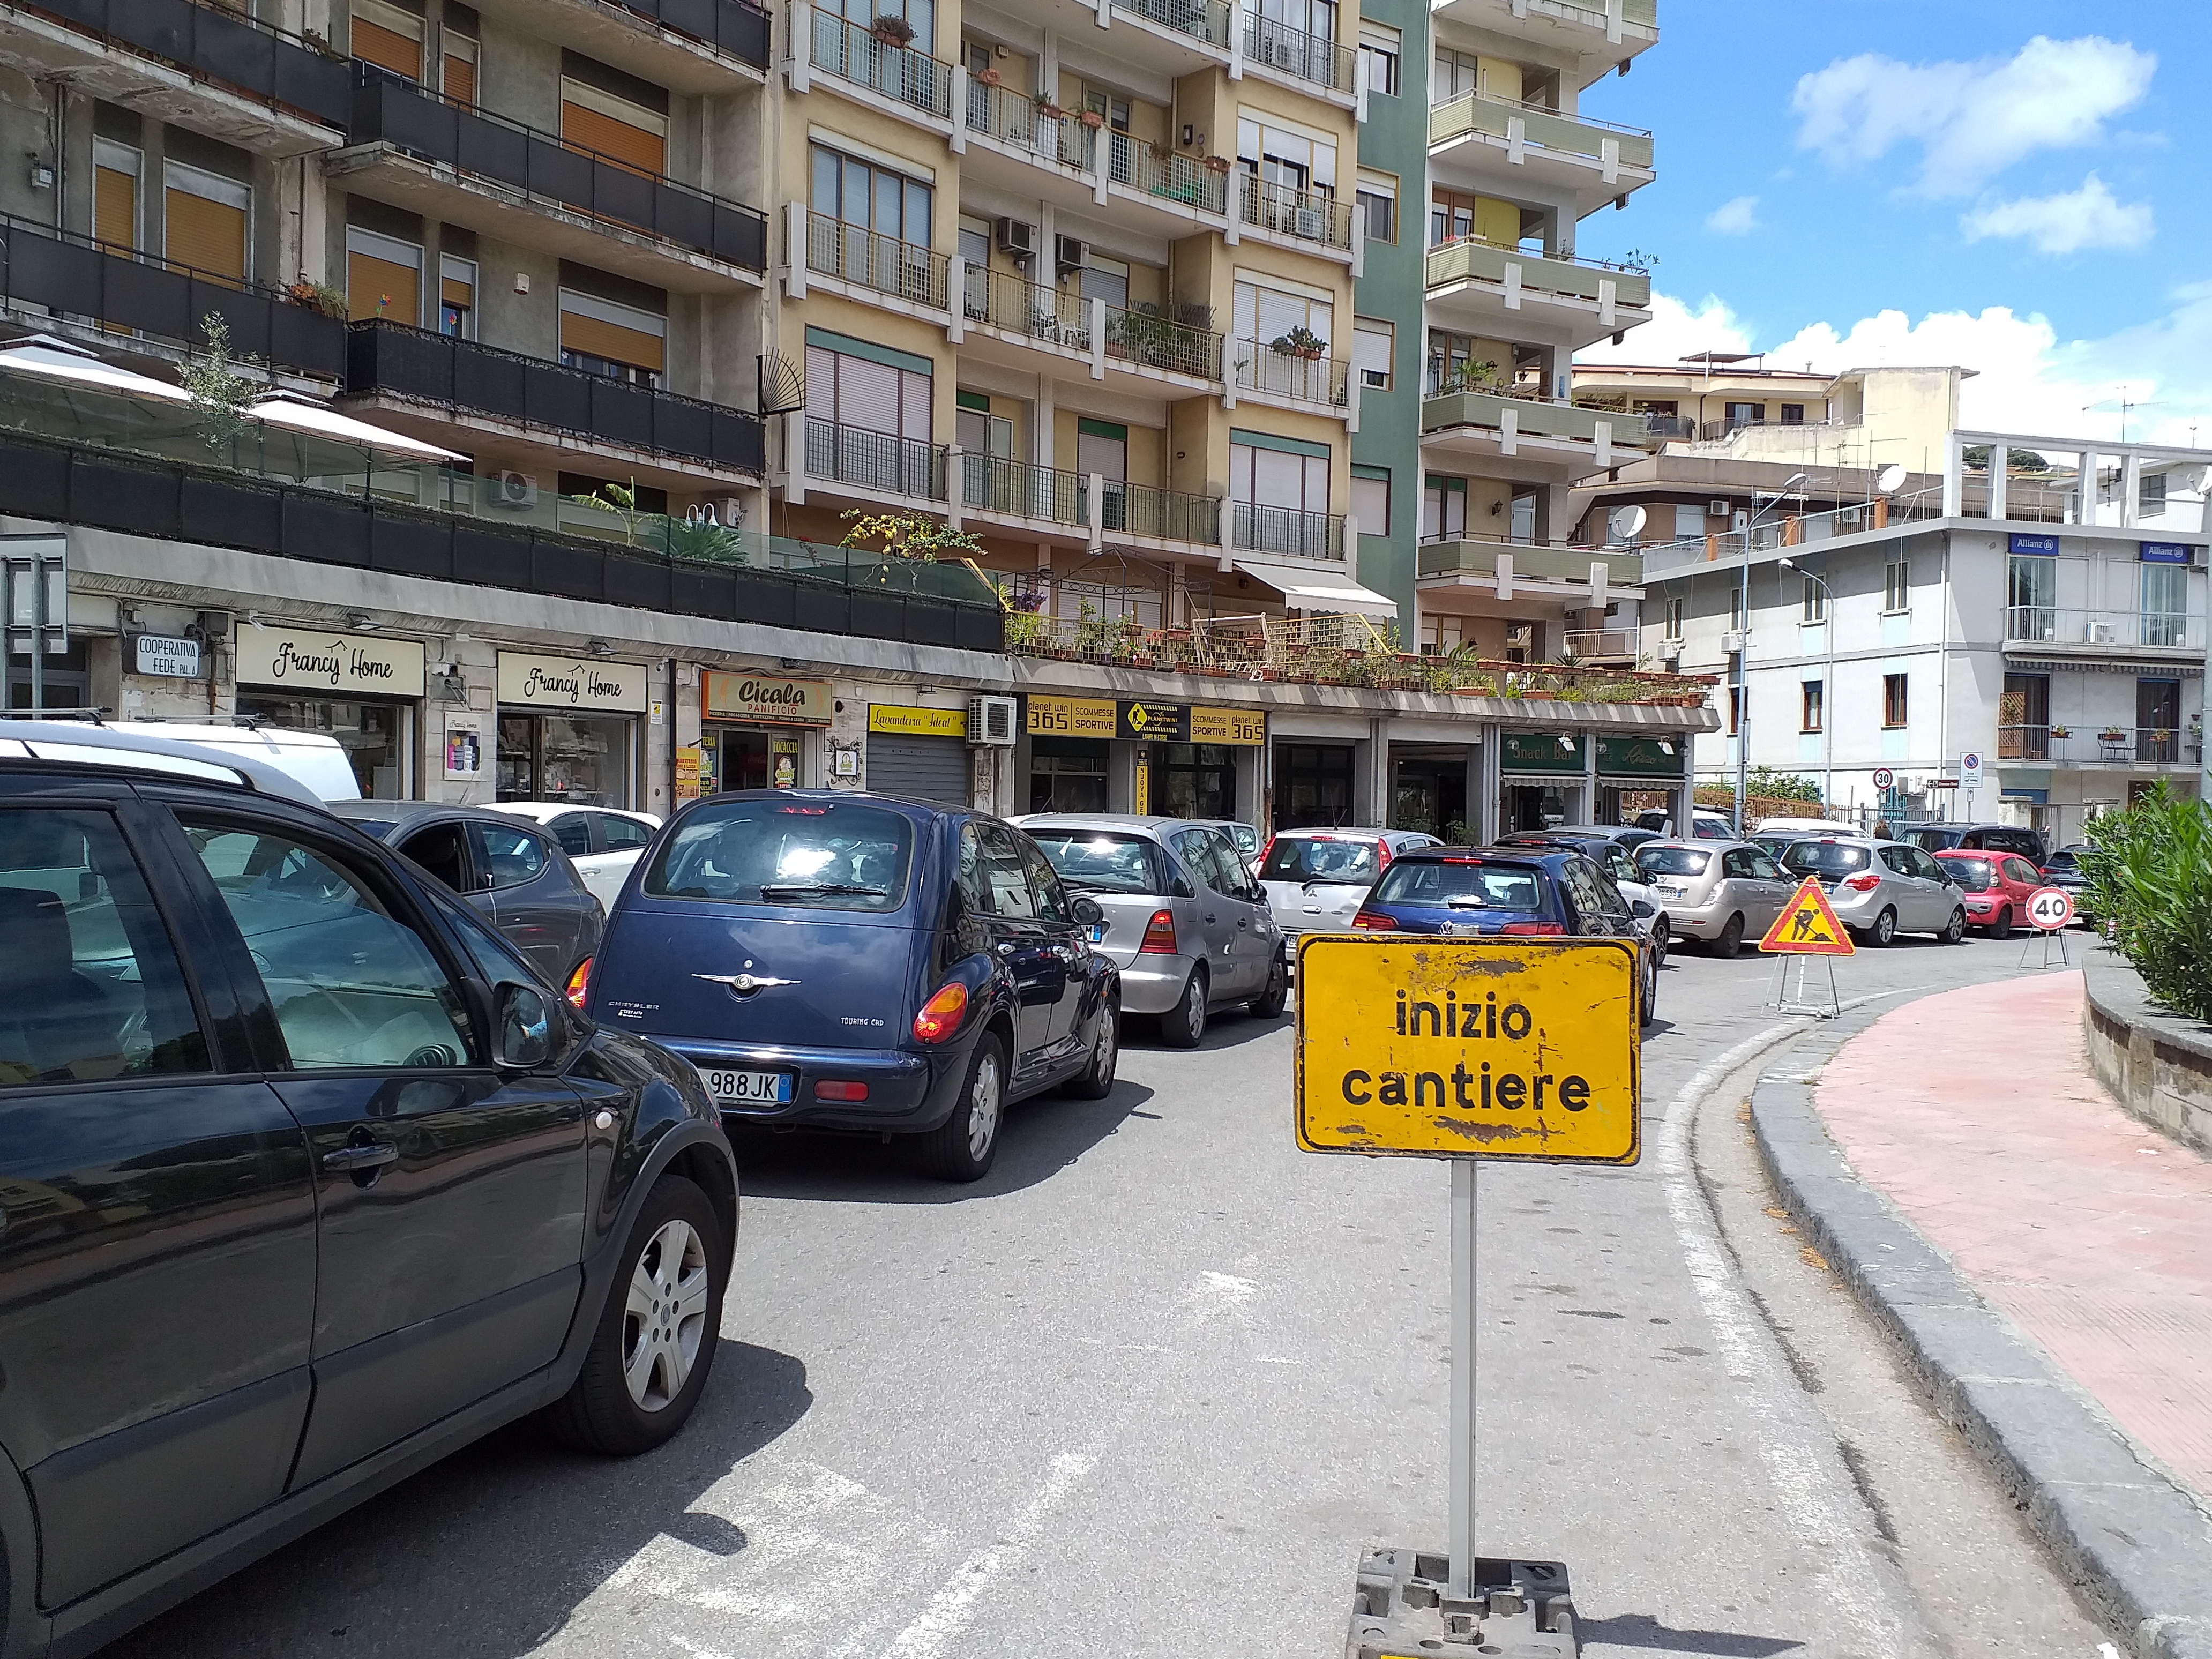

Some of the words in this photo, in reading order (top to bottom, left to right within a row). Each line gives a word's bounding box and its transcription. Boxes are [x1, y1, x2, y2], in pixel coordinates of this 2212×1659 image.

[2017, 538, 2043, 548] Allianz
[2148, 546, 2173, 556] Allianz
[139, 638, 196, 658] COOPERATIVA
[153, 658, 175, 674] FEDE
[273, 642, 340, 685] Francy
[350, 648, 393, 679] Home
[524, 668, 579, 703] Francy
[588, 671, 622, 698] Home
[738, 681, 805, 706] Cicala
[748, 704, 797, 715] PANIFICIO
[1028, 701, 1052, 713] planet
[1055, 704, 1068, 713] win
[1075, 707, 1114, 717] SCOMMESSE
[873, 709, 921, 729] Lavanderia
[1028, 711, 1068, 729] 365
[1075, 720, 1114, 730] SPORTIVE
[1193, 715, 1227, 724] SCOMMESSE
[1232, 715, 1250, 726] planet
[1253, 716, 1264, 724] win
[1192, 726, 1227, 736] SPORTIVE
[1232, 724, 1264, 740] 365
[773, 741, 798, 753] FOCACCIA
[1878, 773, 1889, 783] 30
[2035, 899, 2065, 916] 40
[608, 1001, 659, 1010] CHRYSLER
[1395, 989, 1532, 1040] inizio
[841, 1017, 869, 1026] TOURING
[1342, 1062, 1591, 1112] cantiere
